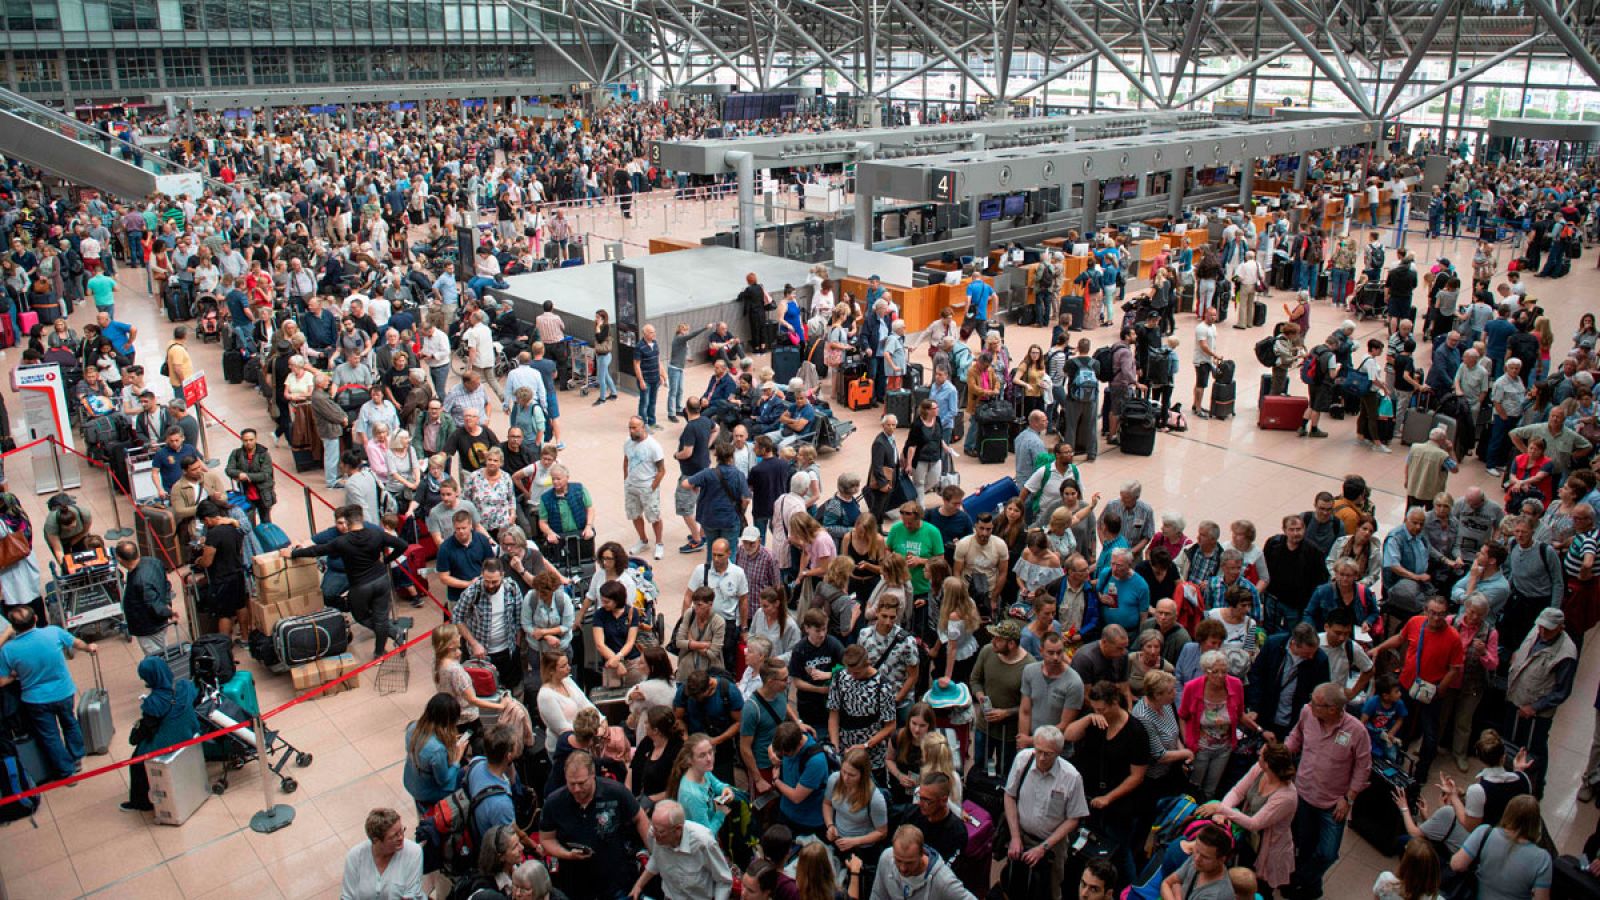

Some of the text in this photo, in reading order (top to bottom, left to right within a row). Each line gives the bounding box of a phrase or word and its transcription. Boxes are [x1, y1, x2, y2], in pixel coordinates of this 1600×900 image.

[1387, 124, 1396, 136] 4
[652, 144, 660, 160] 3
[938, 175, 949, 193] 4
